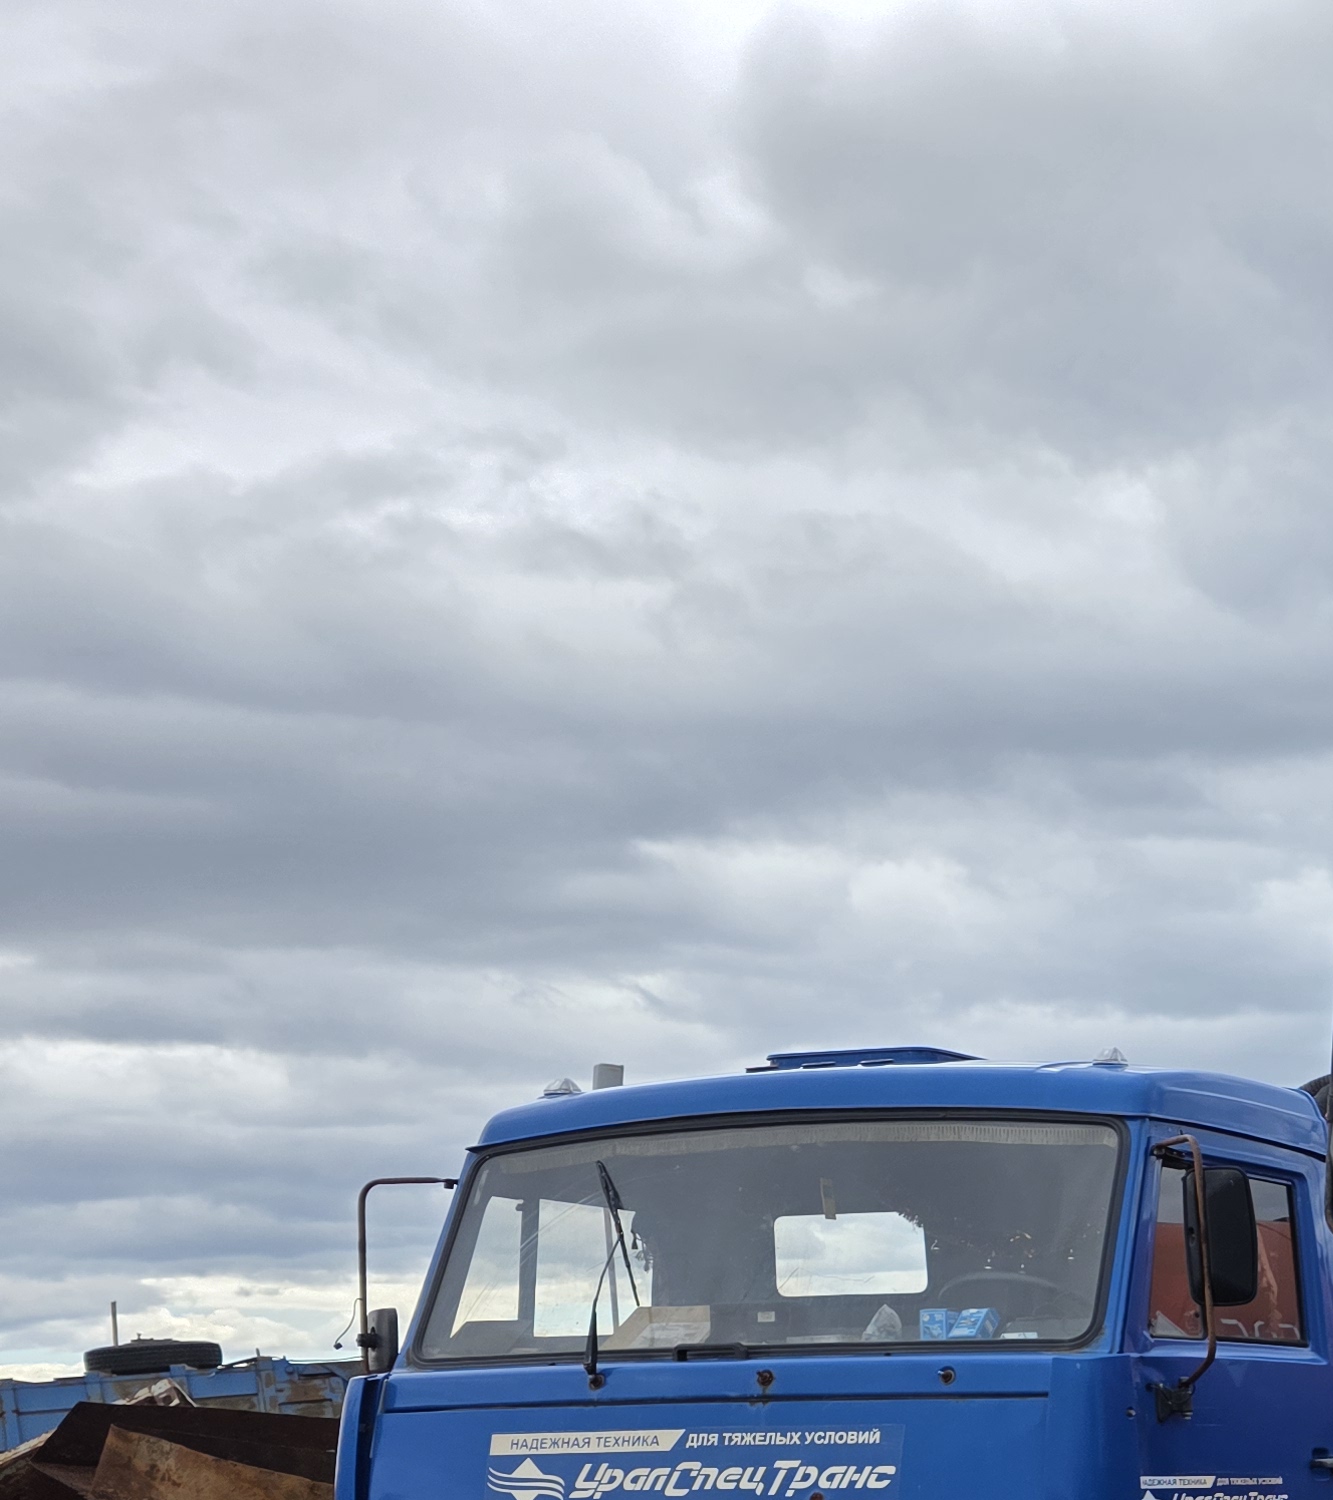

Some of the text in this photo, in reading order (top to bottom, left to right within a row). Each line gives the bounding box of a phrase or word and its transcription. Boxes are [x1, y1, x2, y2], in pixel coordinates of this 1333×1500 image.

[510, 1434, 660, 1451] НАДЕЖНАЯ ТЕХНИКА
[686, 1428, 881, 1449] ДЛЯ ТЯЖЕЛЫХ УСЛОВИЙ
